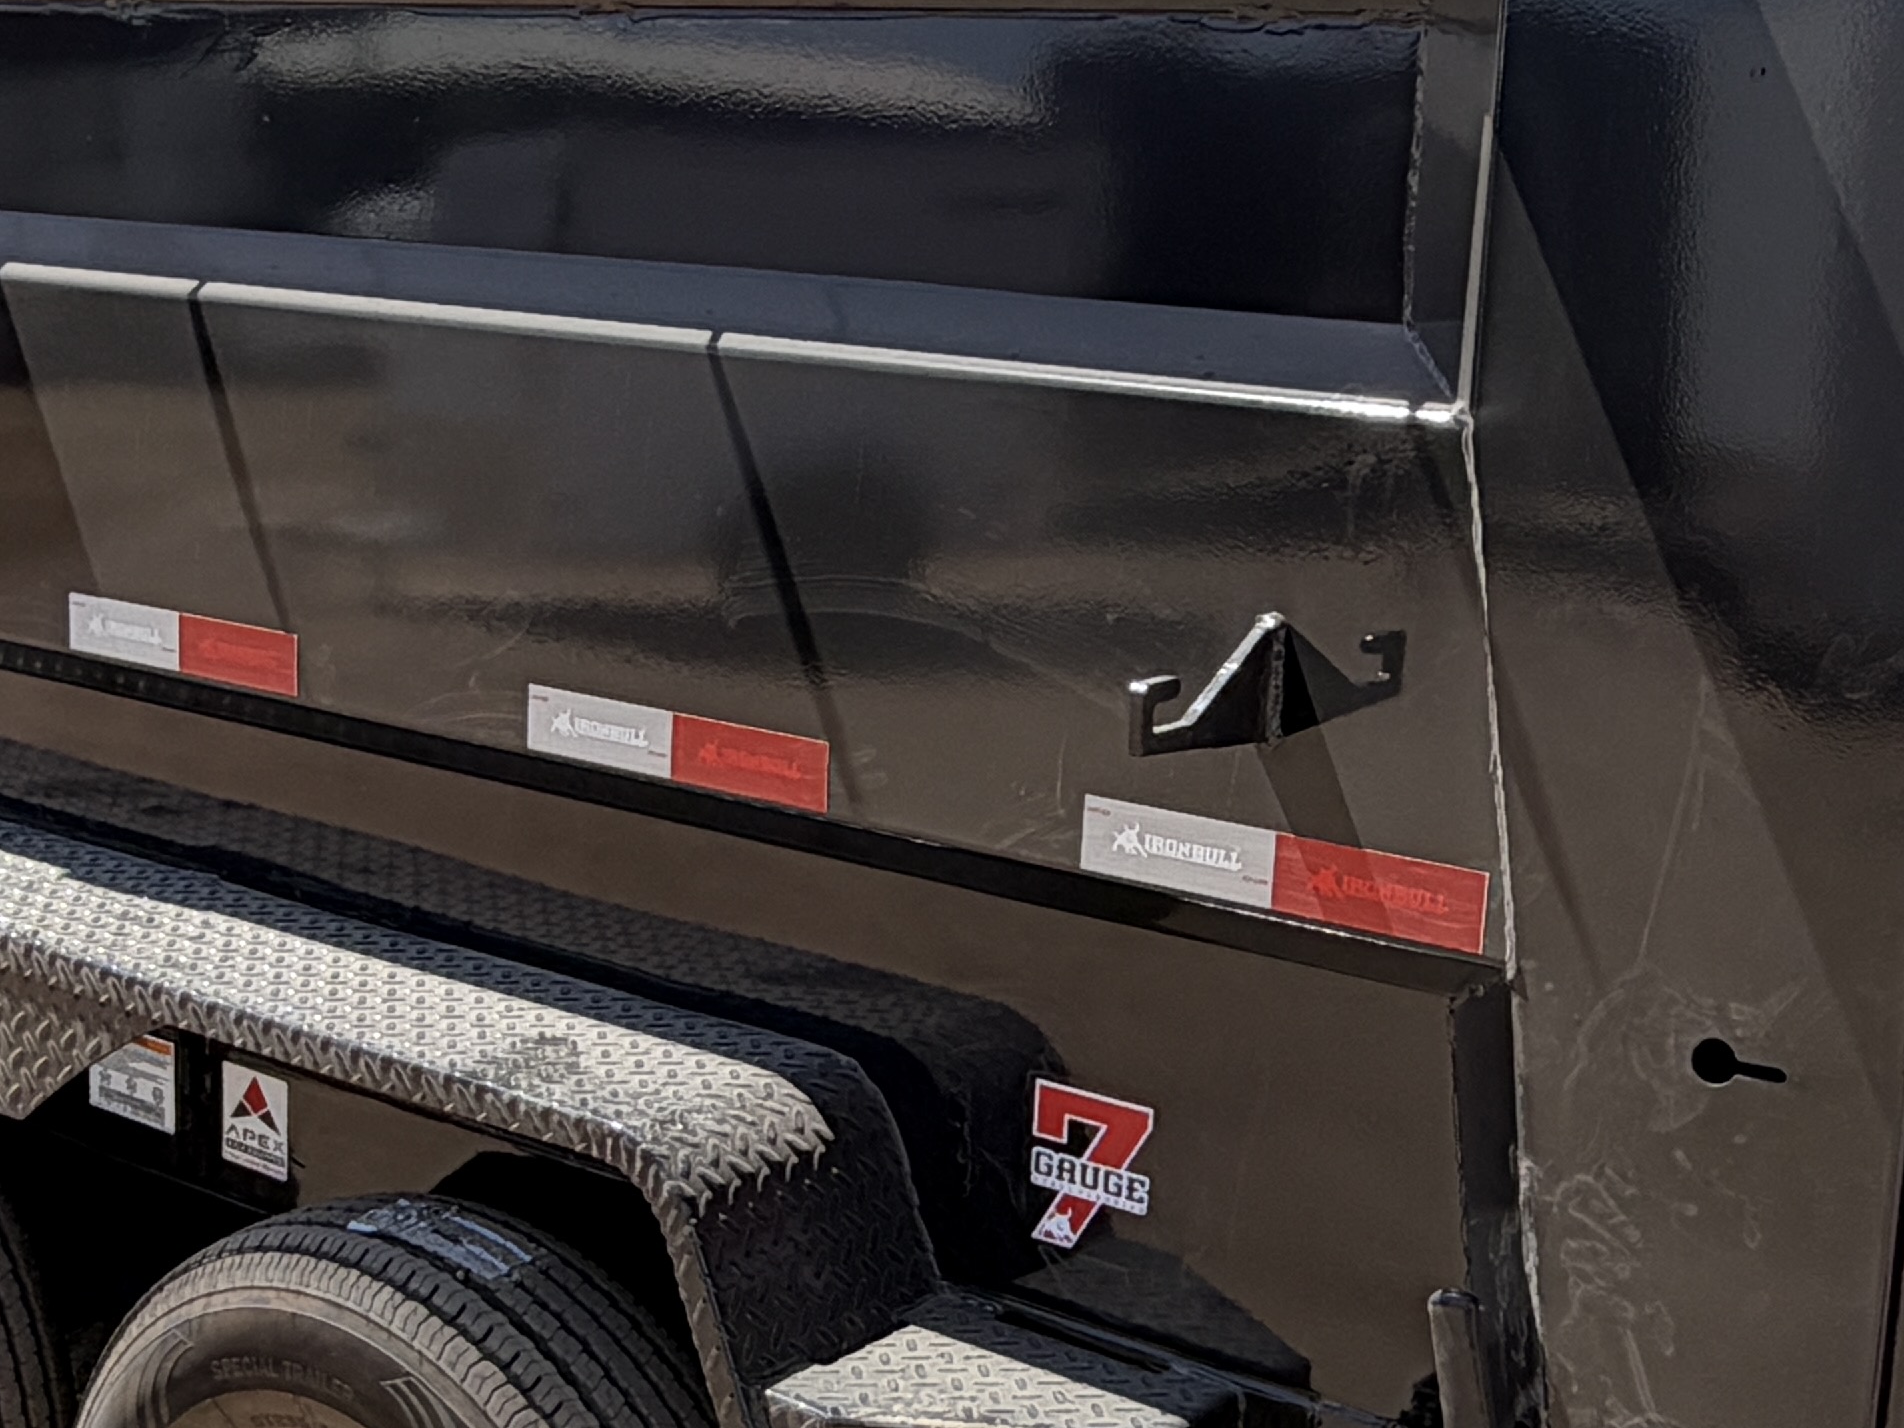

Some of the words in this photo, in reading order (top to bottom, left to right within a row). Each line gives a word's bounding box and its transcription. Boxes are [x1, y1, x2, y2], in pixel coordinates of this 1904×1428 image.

[1143, 832, 1243, 872] IRONBULL
[225, 1123, 285, 1153] APEX
[1034, 1150, 1148, 1204] GAUGE
